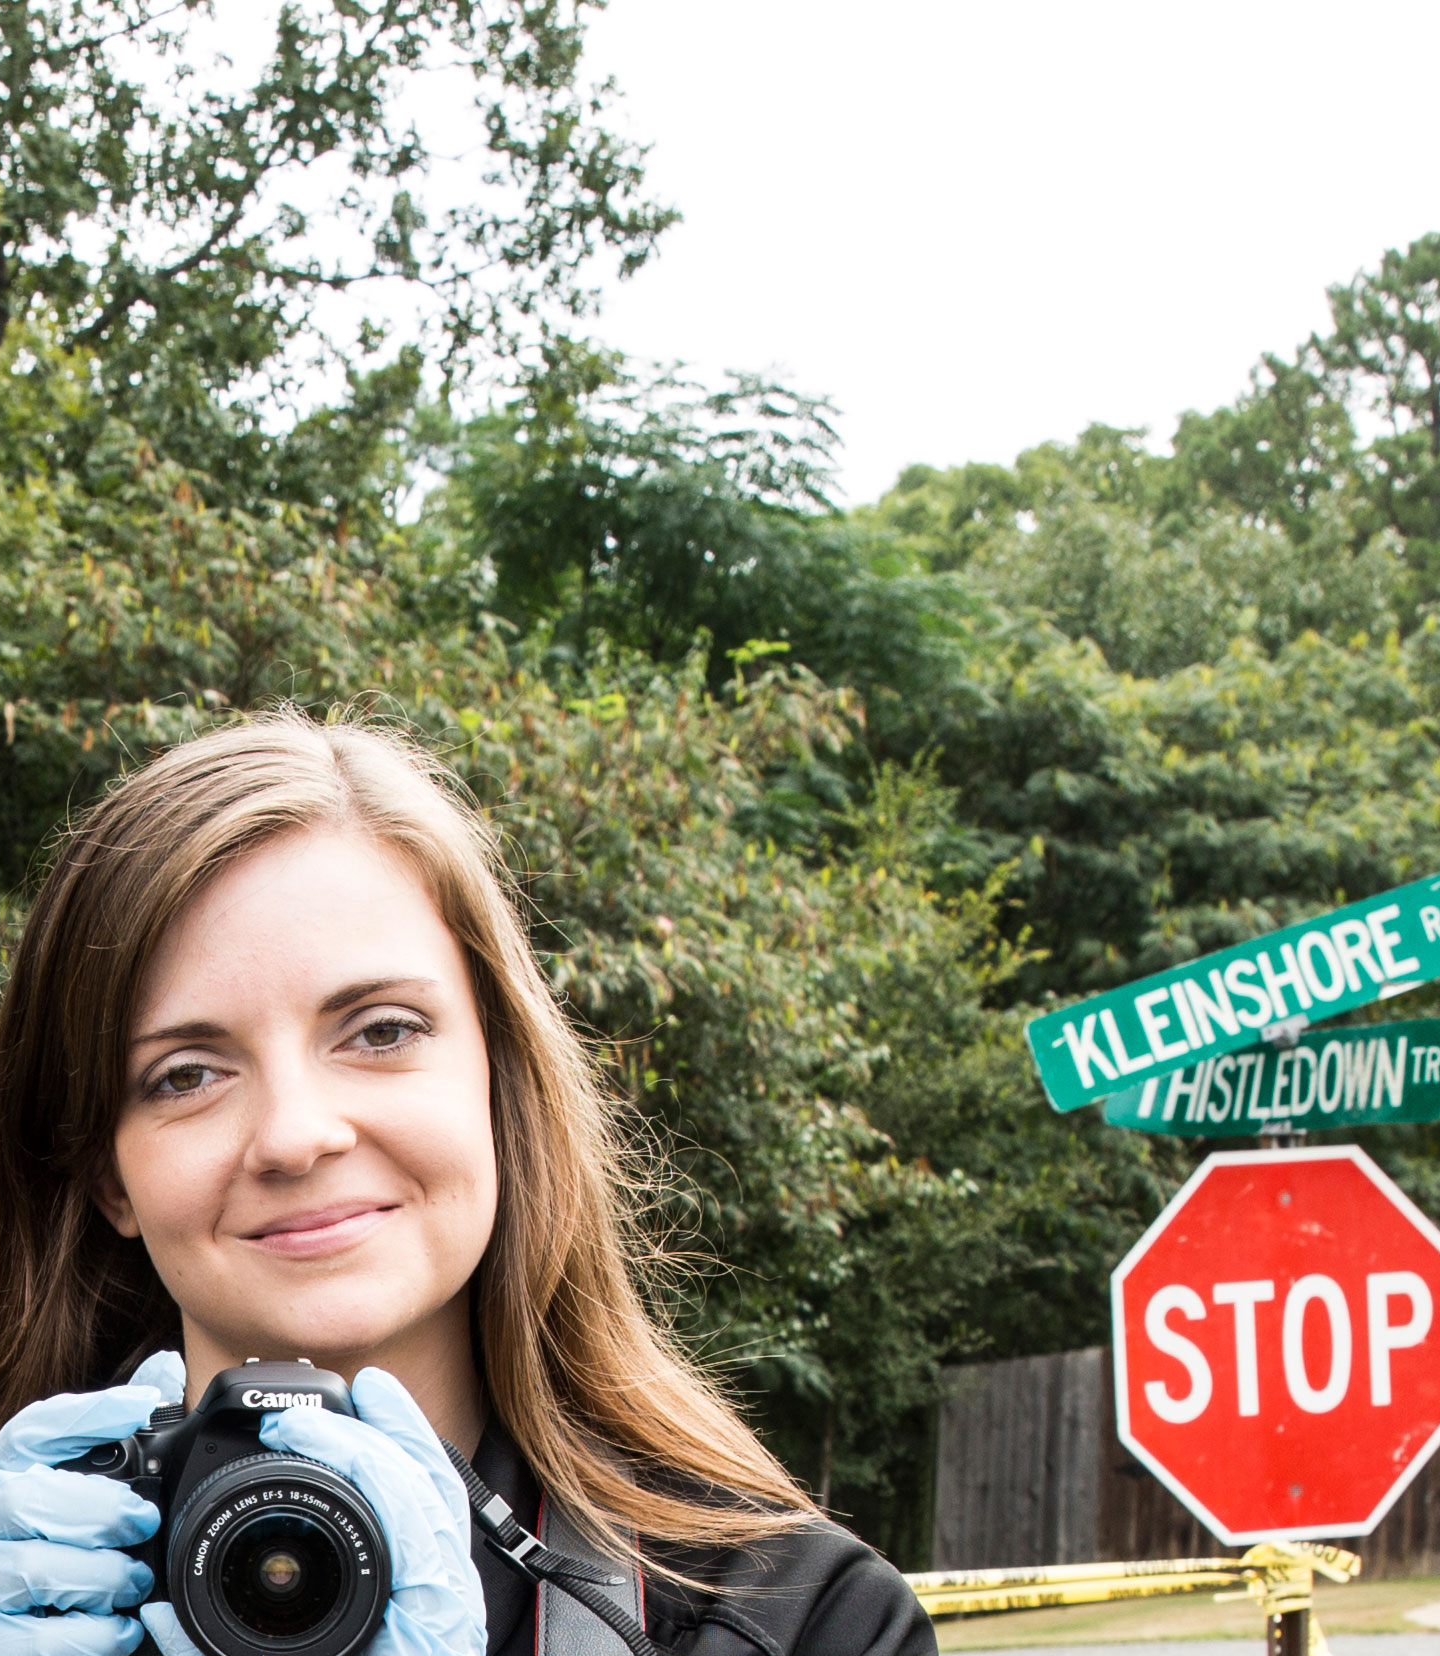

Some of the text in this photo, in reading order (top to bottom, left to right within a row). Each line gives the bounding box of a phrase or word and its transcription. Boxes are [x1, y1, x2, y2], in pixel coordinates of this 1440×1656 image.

[1063, 904, 1419, 1089] KLEINSHORE
[241, 1389, 323, 1408] Canon
[1143, 1269, 1435, 1425] STOP
[193, 1539, 211, 1576] CANON
[207, 1509, 233, 1538] ZOOM
[234, 1494, 258, 1512] LENS
[263, 1490, 283, 1501] EF-S
[289, 1490, 331, 1512] 18-55mm
[333, 1510, 364, 1548] 1:3.5-5.6
[358, 1551, 368, 1562] IS
